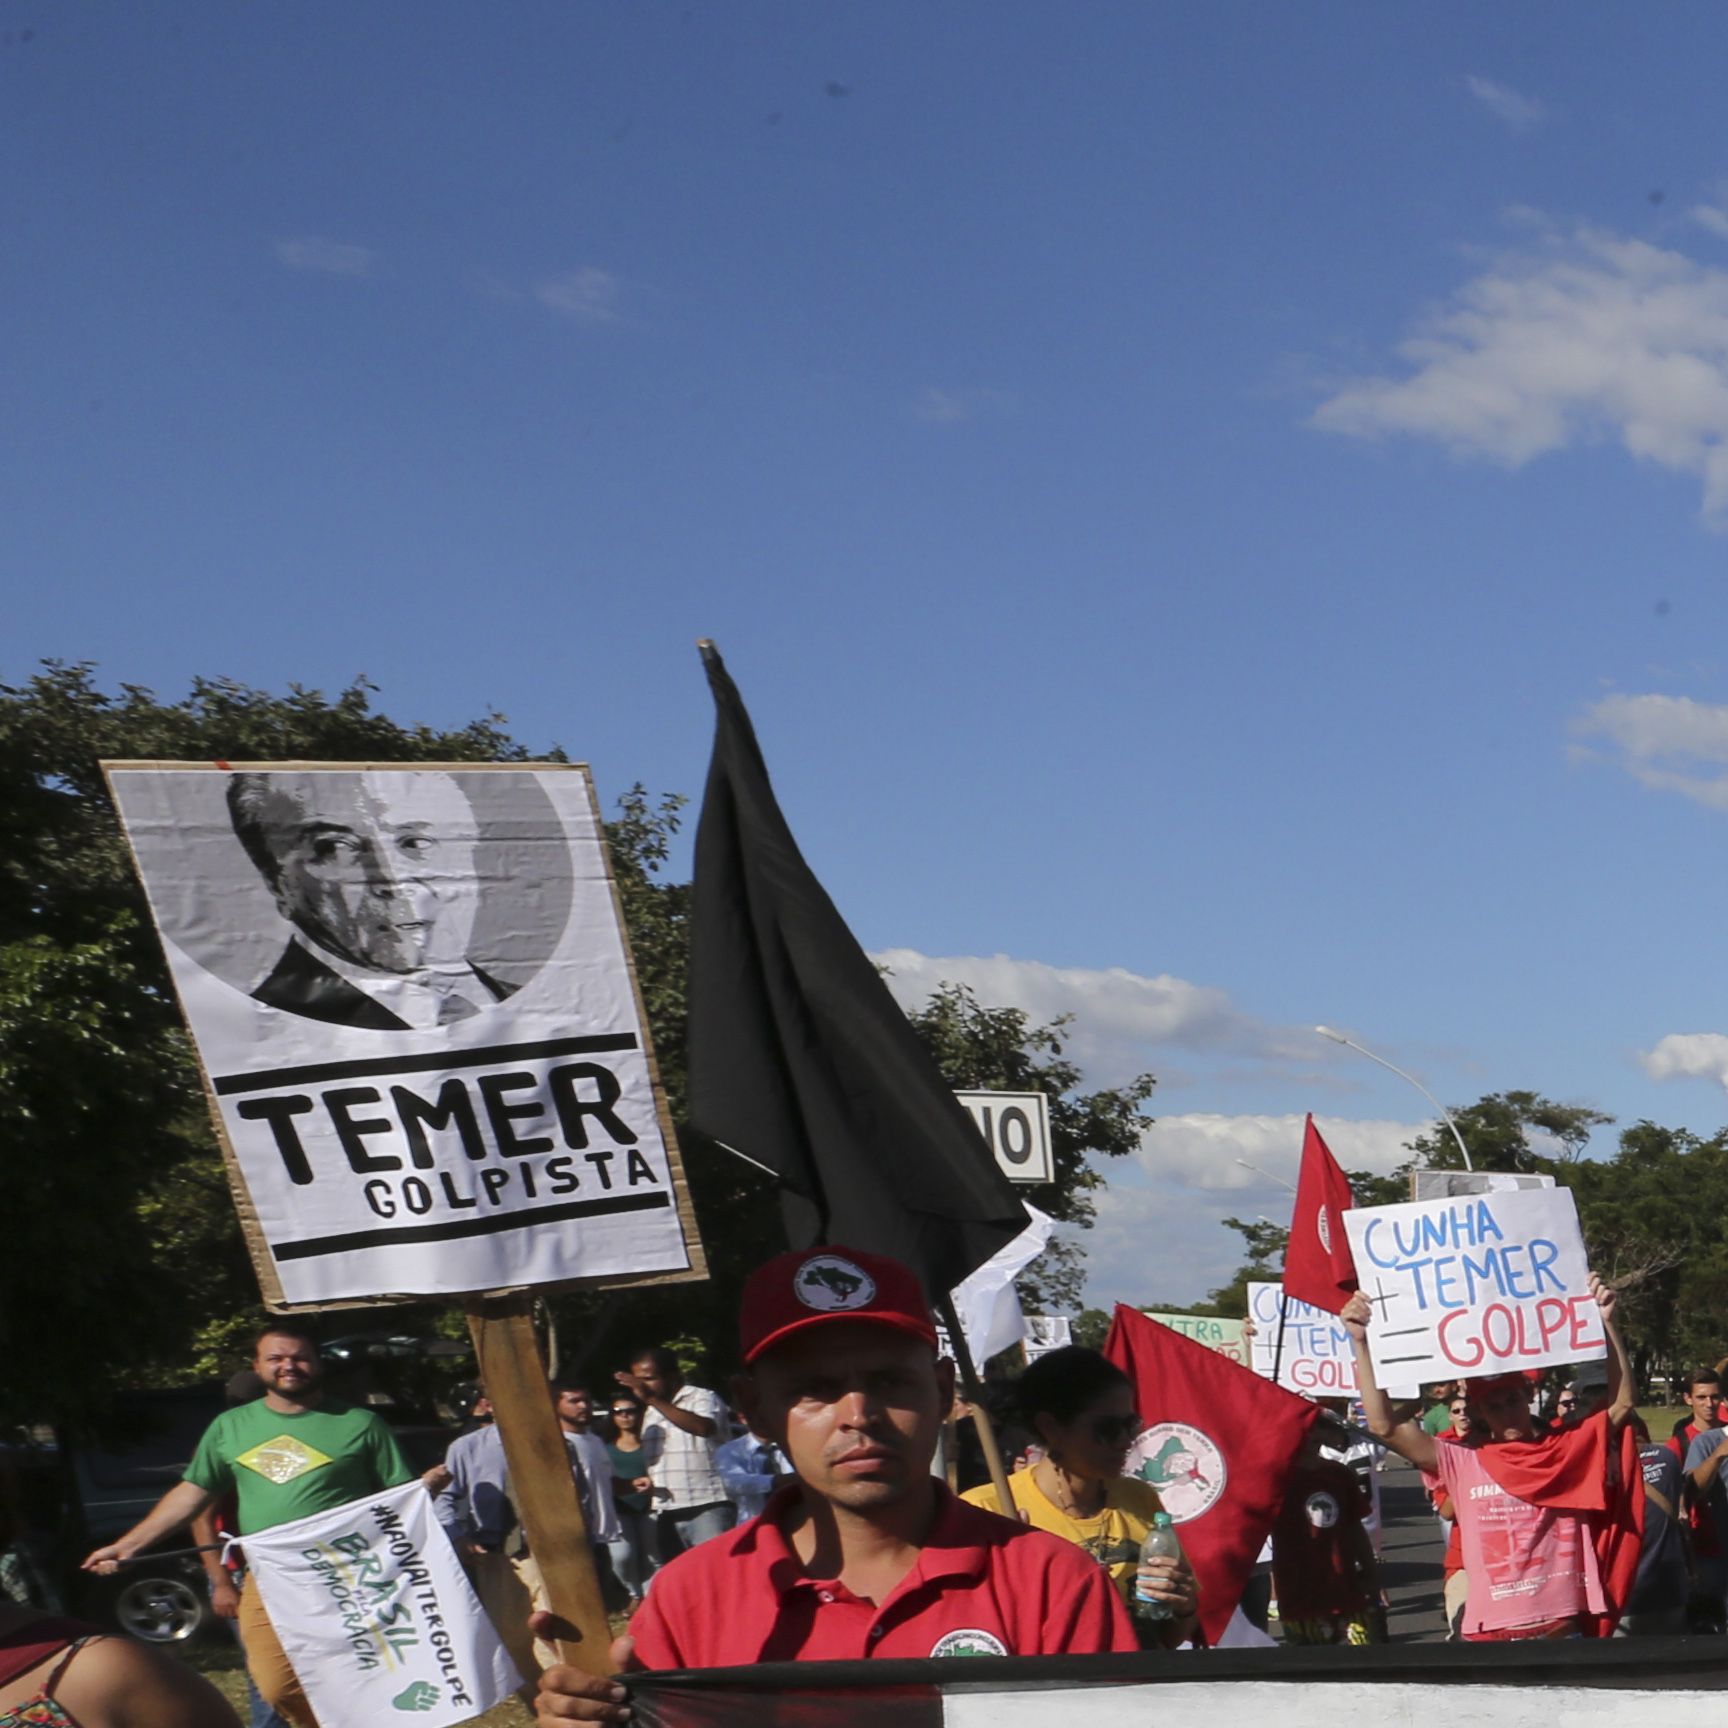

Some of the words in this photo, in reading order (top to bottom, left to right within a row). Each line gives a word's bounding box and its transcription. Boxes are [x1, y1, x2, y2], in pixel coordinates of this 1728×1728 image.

[237, 1061, 638, 1186] TEMER
[364, 1149, 659, 1219] GOLPISTA
[1364, 1199, 1504, 1269] CUNHA
[1394, 1238, 1568, 1311] TEMER
[1437, 1293, 1606, 1368] GOLPE
[302, 1547, 380, 1671] DEMOCRACIA
[330, 1531, 420, 1665] BRASIL
[368, 1503, 473, 1708] #NAOVAITERGOLPE
